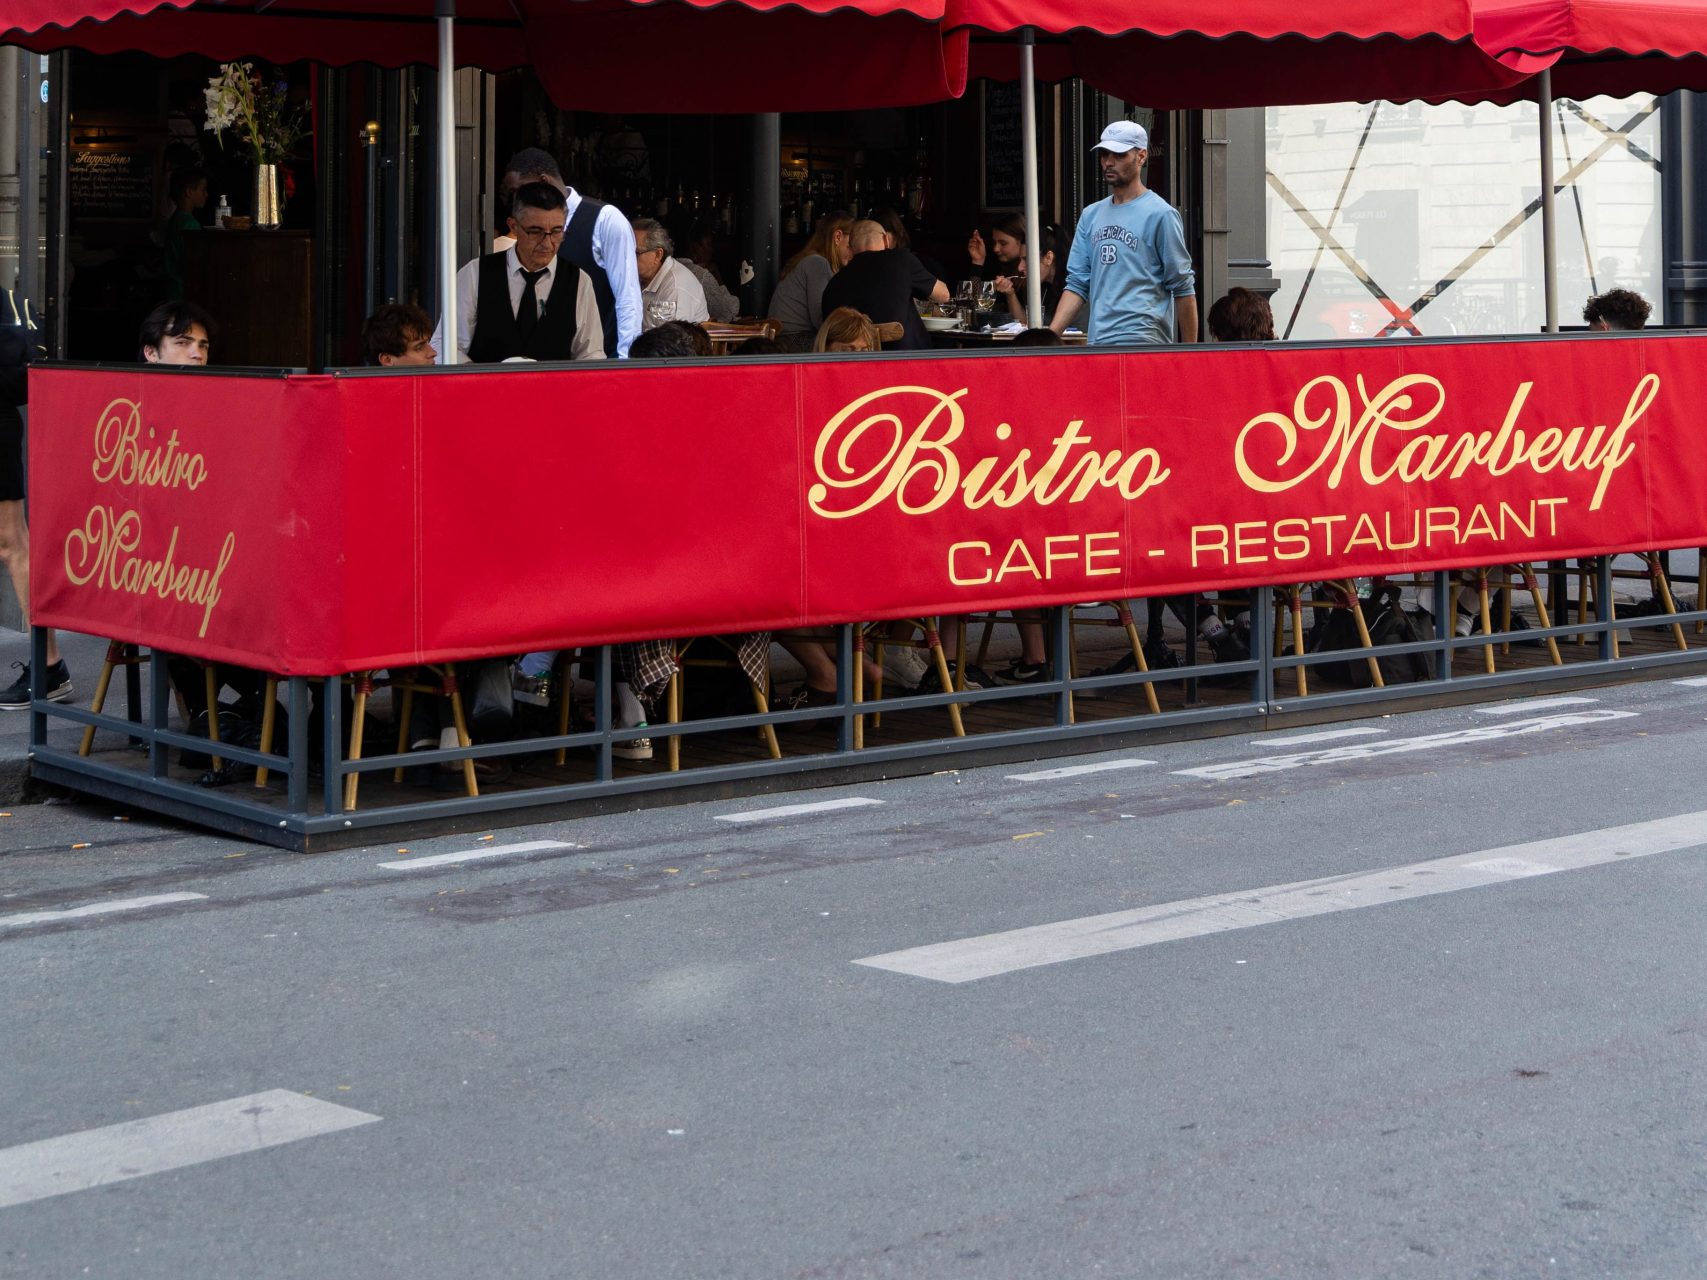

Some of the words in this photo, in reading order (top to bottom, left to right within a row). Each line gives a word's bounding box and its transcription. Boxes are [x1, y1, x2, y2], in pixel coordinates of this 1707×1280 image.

[93, 398, 207, 491] Bistro
[808, 385, 1171, 518] Bistro
[1234, 373, 1660, 512] Marbeuf
[65, 505, 235, 638] Marbeuf
[948, 532, 1121, 586] CAFE
[1191, 498, 1568, 568] RESTAURANT
